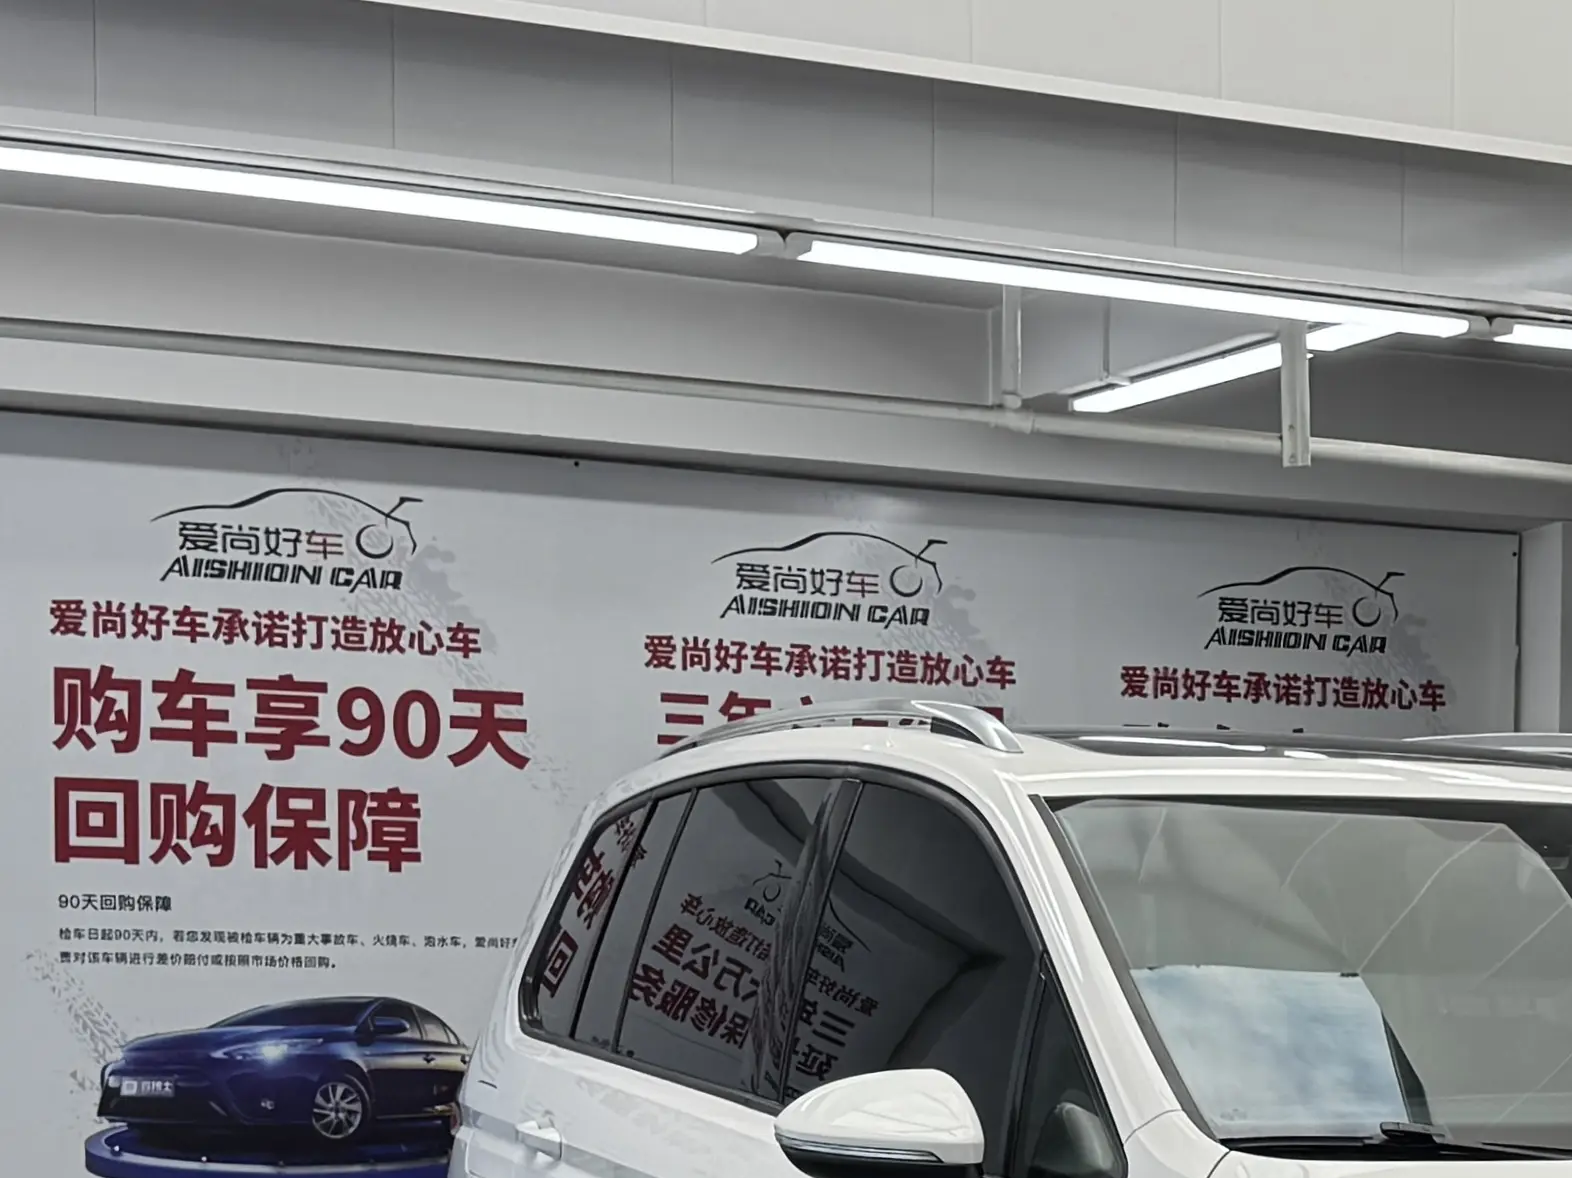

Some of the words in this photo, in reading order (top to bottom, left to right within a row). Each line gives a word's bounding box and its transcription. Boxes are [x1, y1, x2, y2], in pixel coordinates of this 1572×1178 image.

[178, 520, 345, 561] 爱尚好车
[329, 566, 403, 593] CAR
[735, 562, 880, 599] 爱尚好车
[49, 600, 482, 659] 爱尚好车承诺打造放心车
[867, 605, 930, 629] CAR
[1217, 596, 1344, 630] 爱尚好车
[643, 634, 1017, 688] 爱尚好车承诺打造放心车
[1332, 635, 1387, 657] CAR
[1120, 665, 1446, 712] 爱尚好车承诺打造放心车
[52, 664, 532, 771] 购车享90天
[53, 775, 423, 873] 回购保障
[58, 893, 173, 912] 90天回购保障
